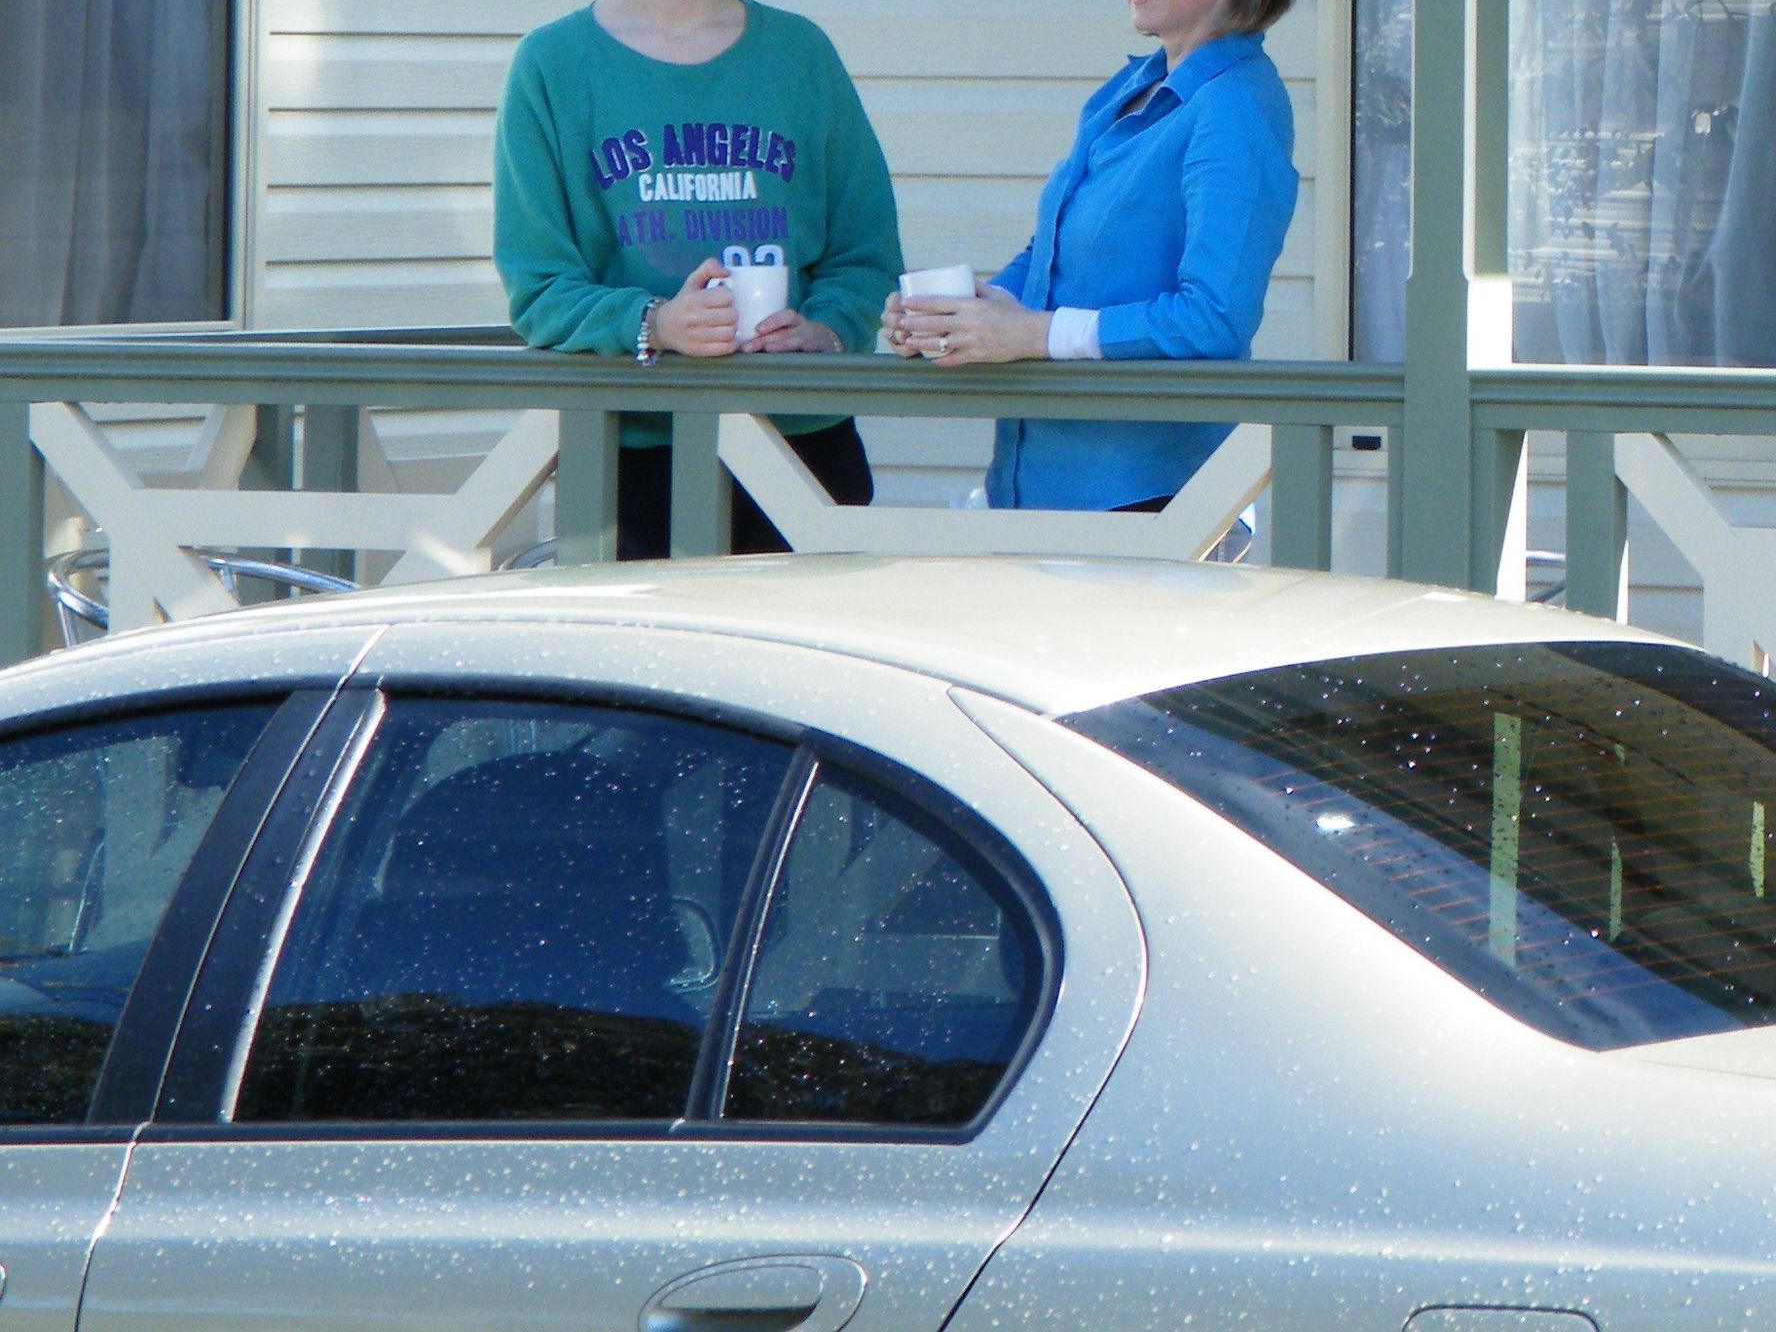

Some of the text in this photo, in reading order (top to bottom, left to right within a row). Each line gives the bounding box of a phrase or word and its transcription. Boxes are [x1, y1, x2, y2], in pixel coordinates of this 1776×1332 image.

[590, 123, 795, 190] LOS ANGELES
[638, 171, 757, 202] CALIFORNIA
[685, 206, 789, 242] DIVISION
